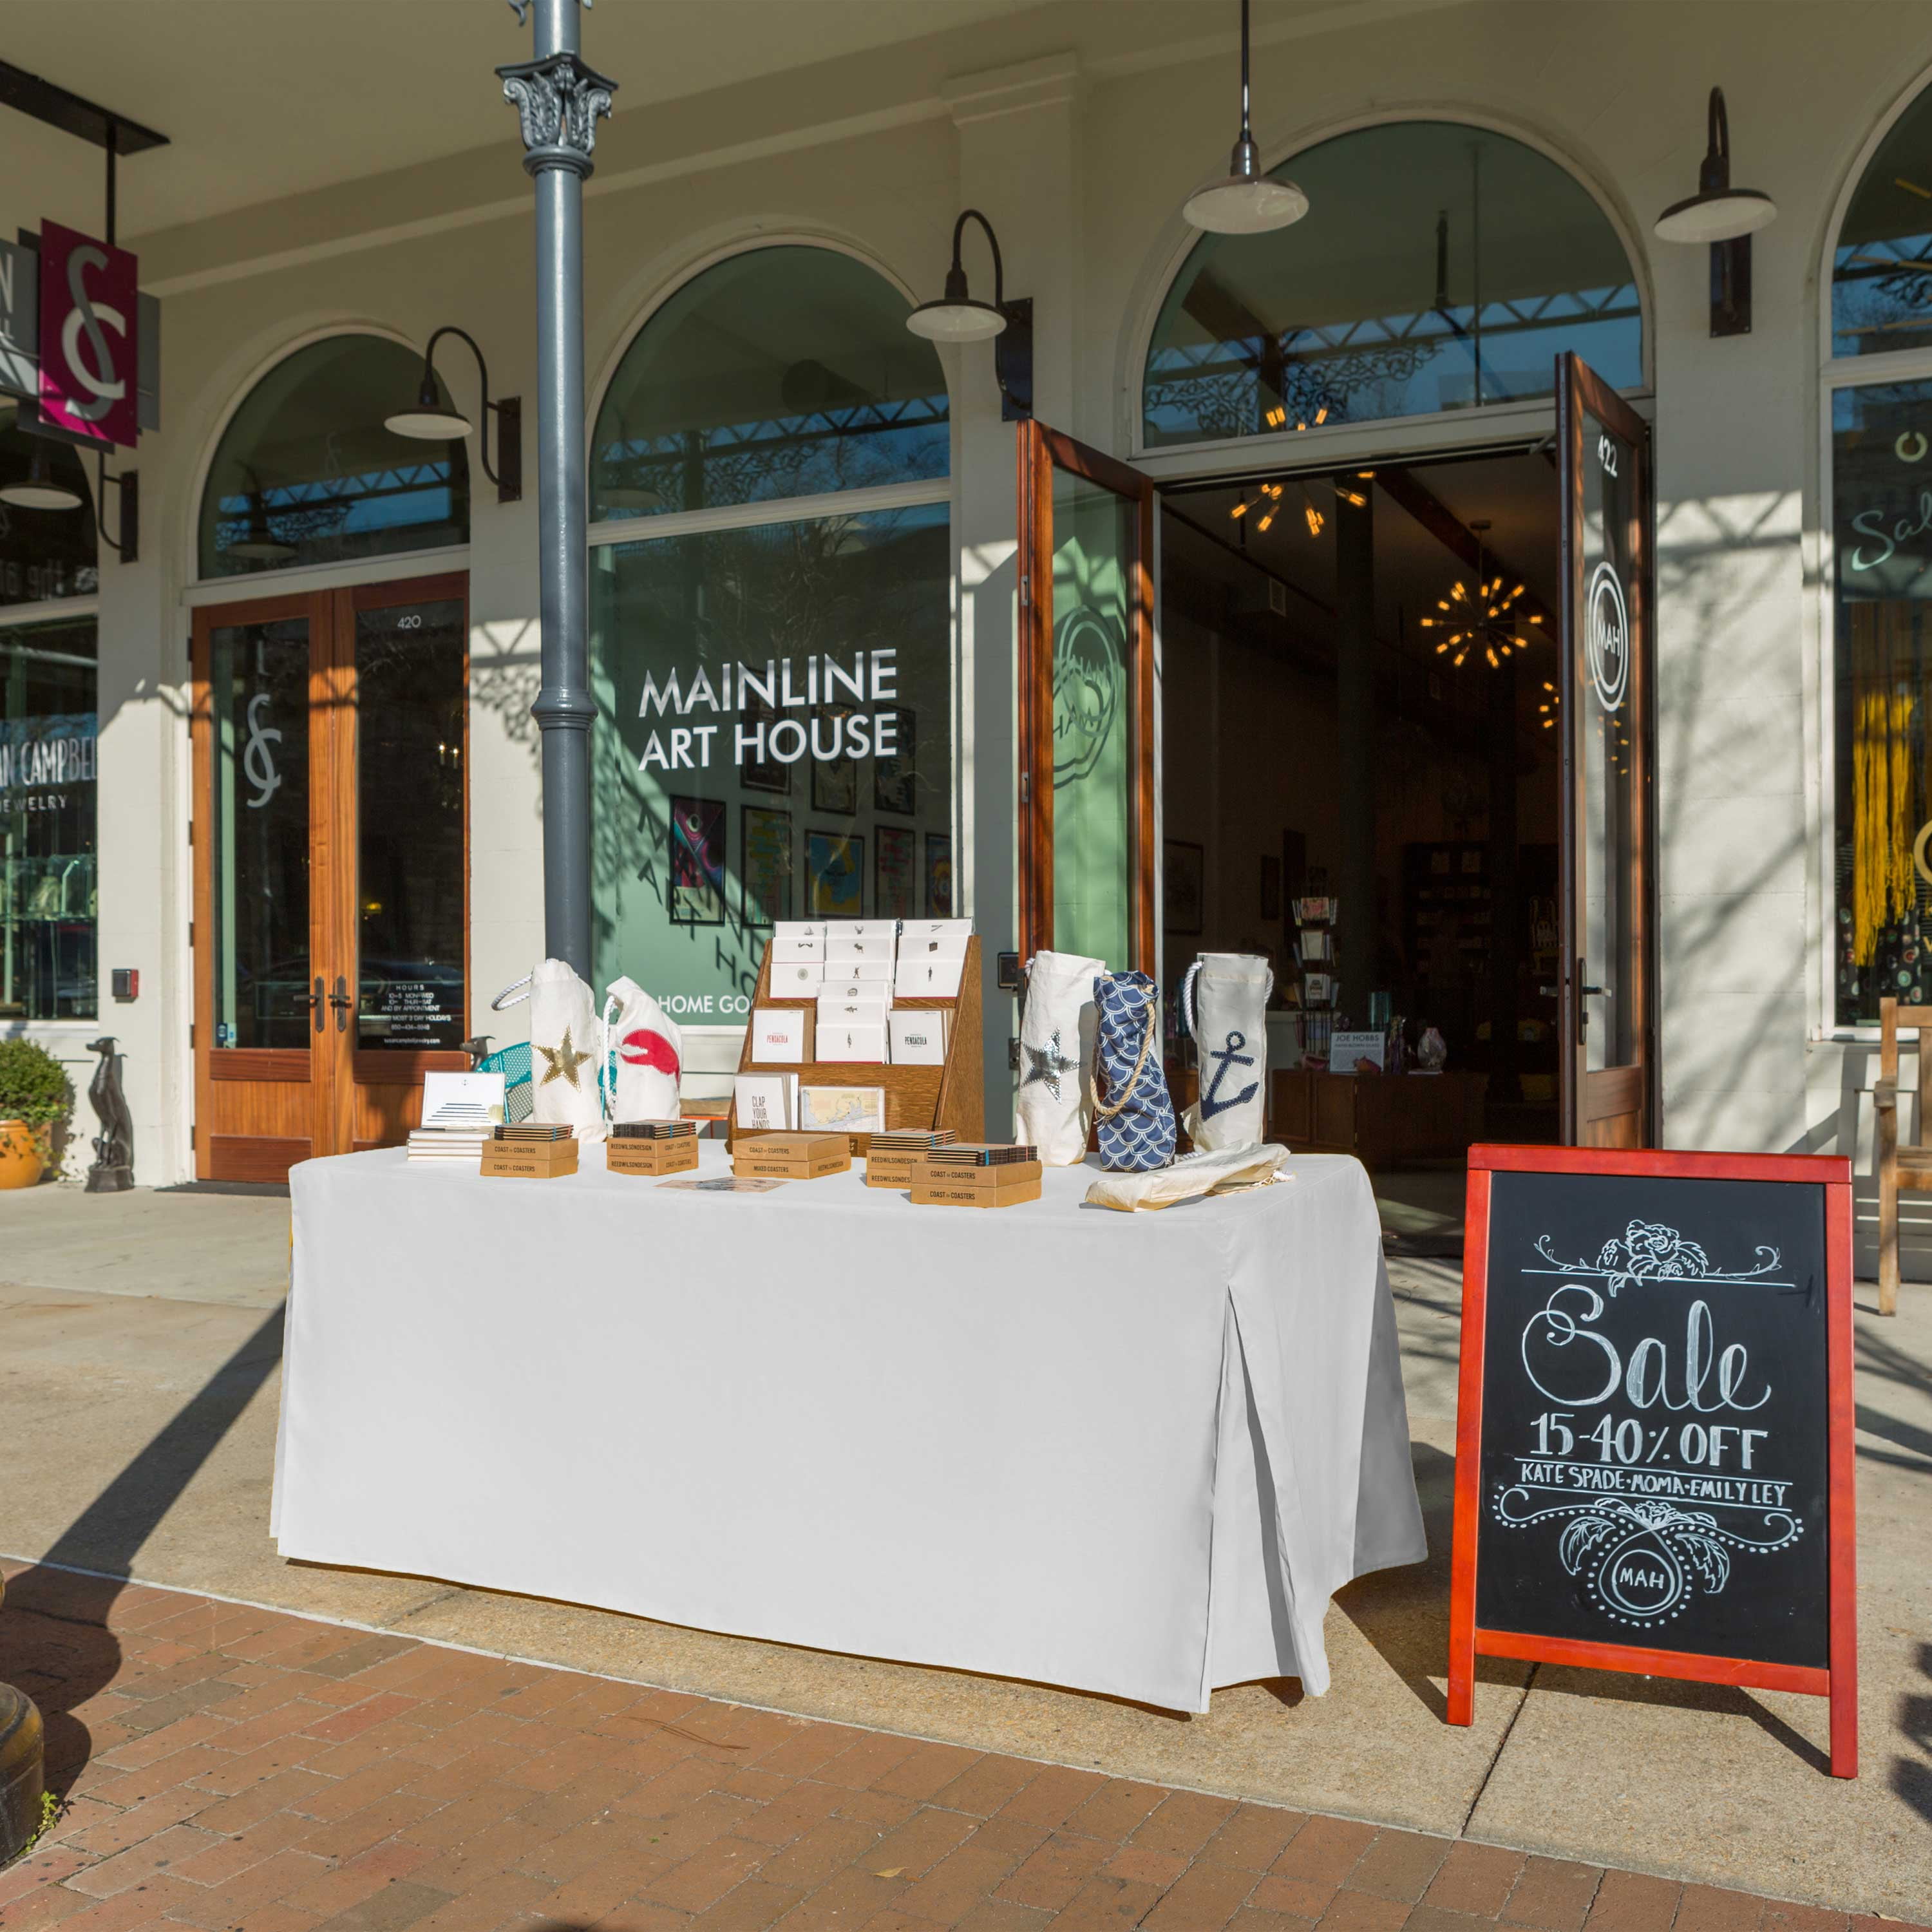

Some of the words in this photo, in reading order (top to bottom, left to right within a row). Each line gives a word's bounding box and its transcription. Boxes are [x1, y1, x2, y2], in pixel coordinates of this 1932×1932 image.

[1598, 435, 1618, 478] 422
[397, 615, 421, 629] 420
[1596, 618, 1620, 657] MAH
[639, 649, 896, 718] MAINLINE
[638, 726, 718, 771] ART
[734, 712, 896, 765] HOUSE
[659, 995, 713, 1014] HOME
[719, 995, 754, 1014] GO
[766, 1035, 788, 1043] PENSACOLA
[905, 1036, 927, 1045] PENSACOLA
[752, 1096, 765, 1107] CLAP
[752, 1119, 770, 1129] HANDS
[753, 1108, 767, 1119] YOUR
[1522, 1283, 1772, 1412] Sale
[1680, 1423, 1768, 1469] OFF
[1521, 1463, 1564, 1483] KATE
[1752, 1484, 1786, 1506] LEY
[1619, 1567, 1664, 1589] MAH
